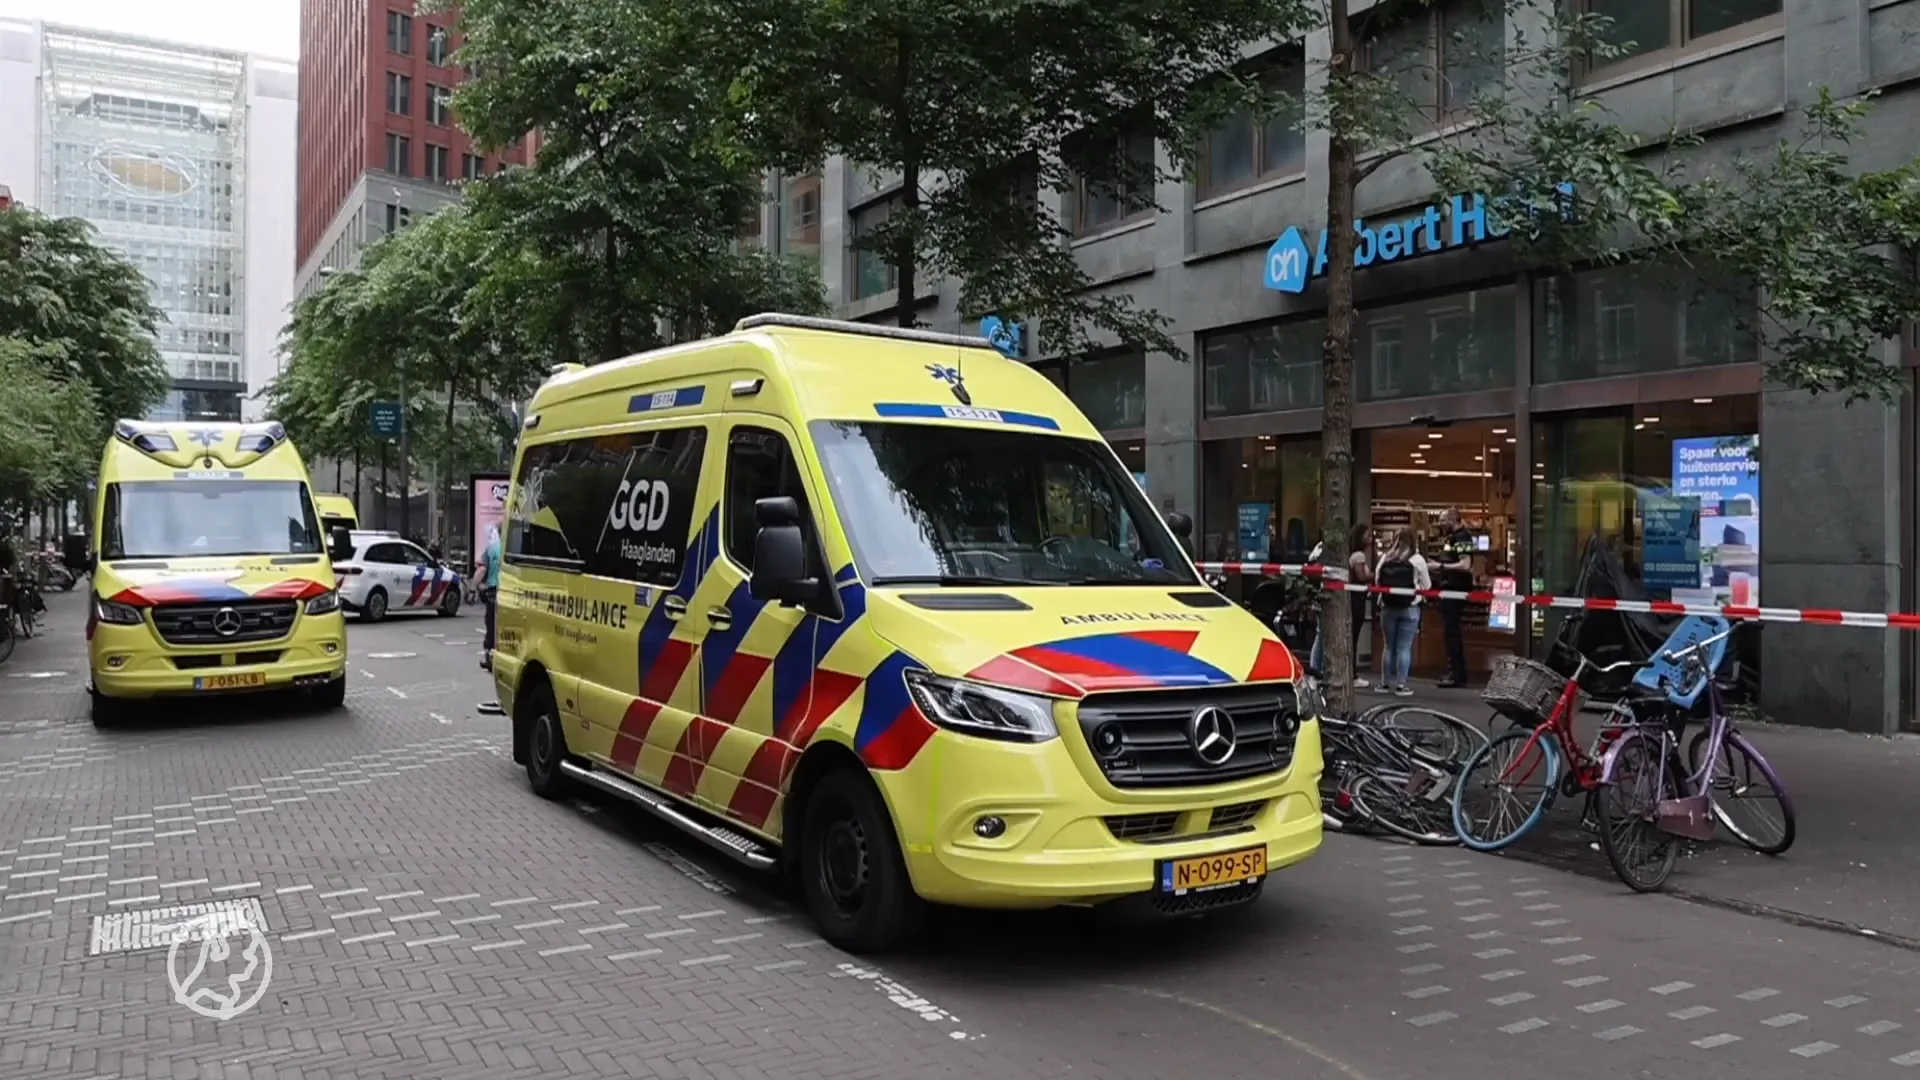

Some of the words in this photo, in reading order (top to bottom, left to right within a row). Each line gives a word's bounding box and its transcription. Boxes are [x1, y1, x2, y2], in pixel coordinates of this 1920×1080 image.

[1679, 447, 1717, 462] Spaar
[1719, 446, 1750, 458] voor
[1679, 458, 1760, 474] buitenservie
[1679, 477, 1695, 488] en
[1698, 474, 1738, 487] sterke
[610, 479, 670, 531] GGD
[620, 538, 676, 567] Haaglanden
[546, 593, 628, 629] AMBULANCE
[1060, 612, 1212, 625] AMBULANCE
[1178, 852, 1262, 886] N-099-SP
